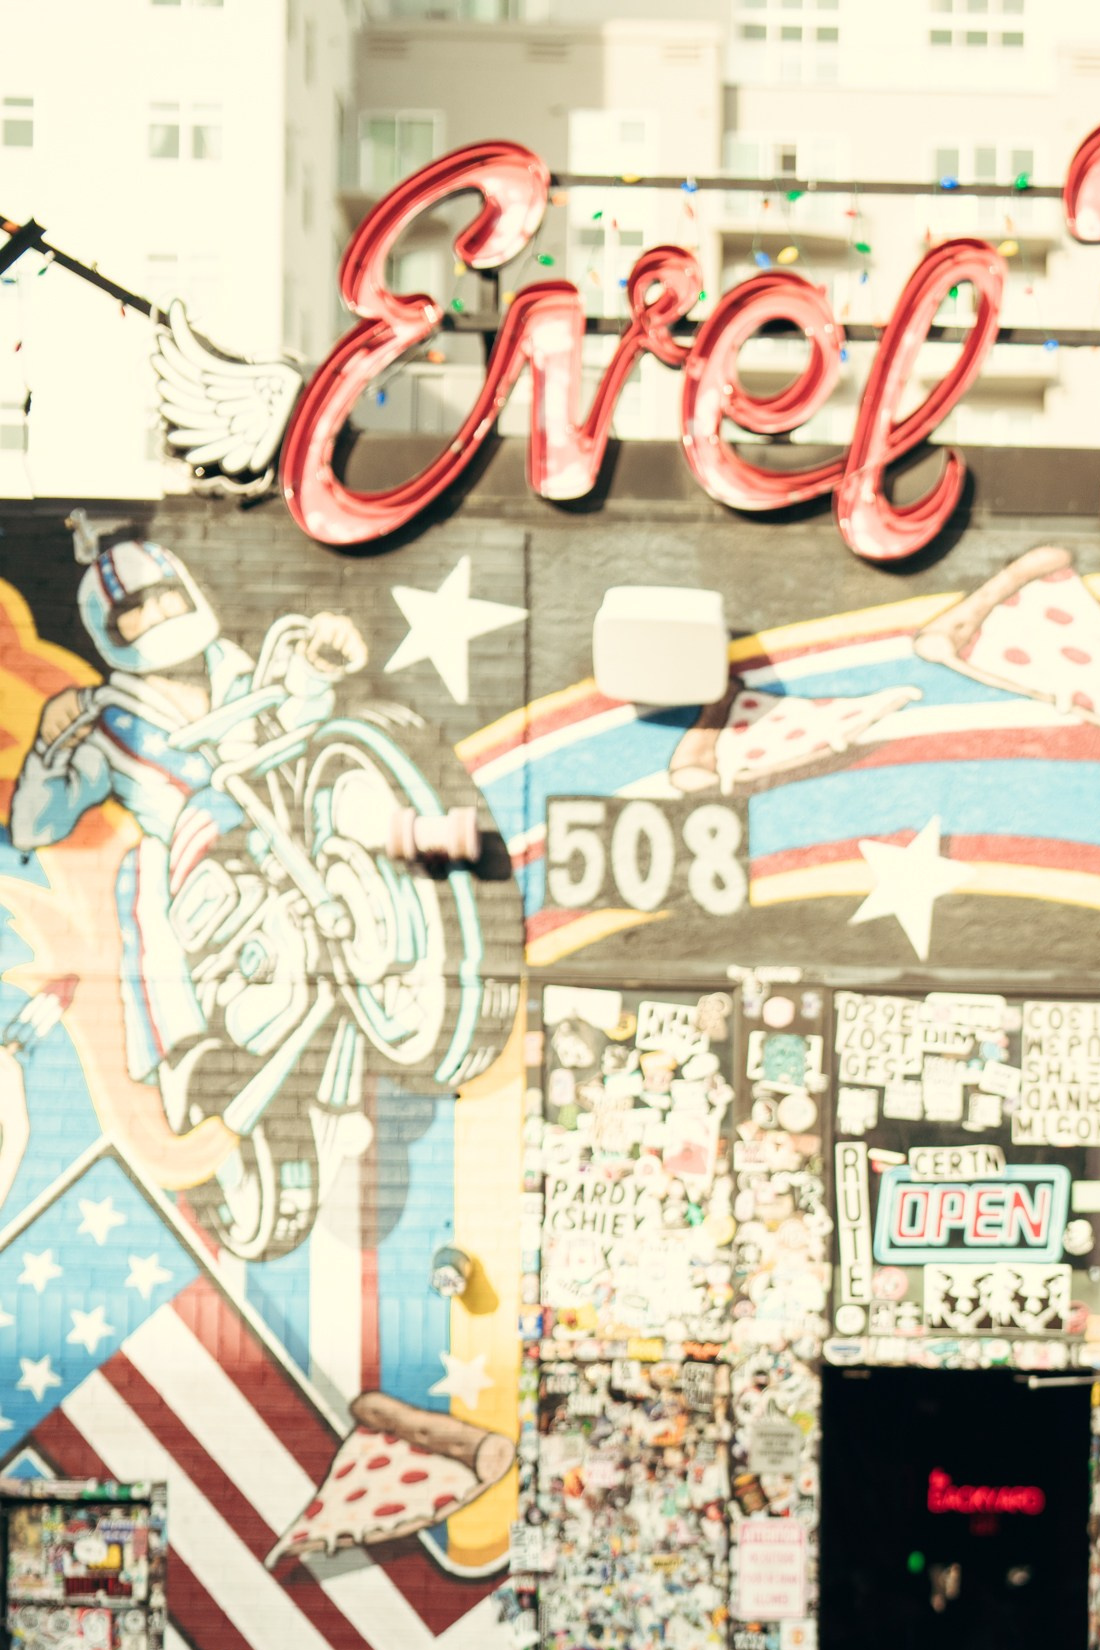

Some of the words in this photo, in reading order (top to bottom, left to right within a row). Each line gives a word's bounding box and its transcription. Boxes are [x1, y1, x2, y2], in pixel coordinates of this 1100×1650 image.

[281, 139, 1006, 562] Evel
[549, 799, 749, 917] 508
[842, 1147, 864, 1298] RUTE
[895, 1186, 1052, 1243] OPEN
